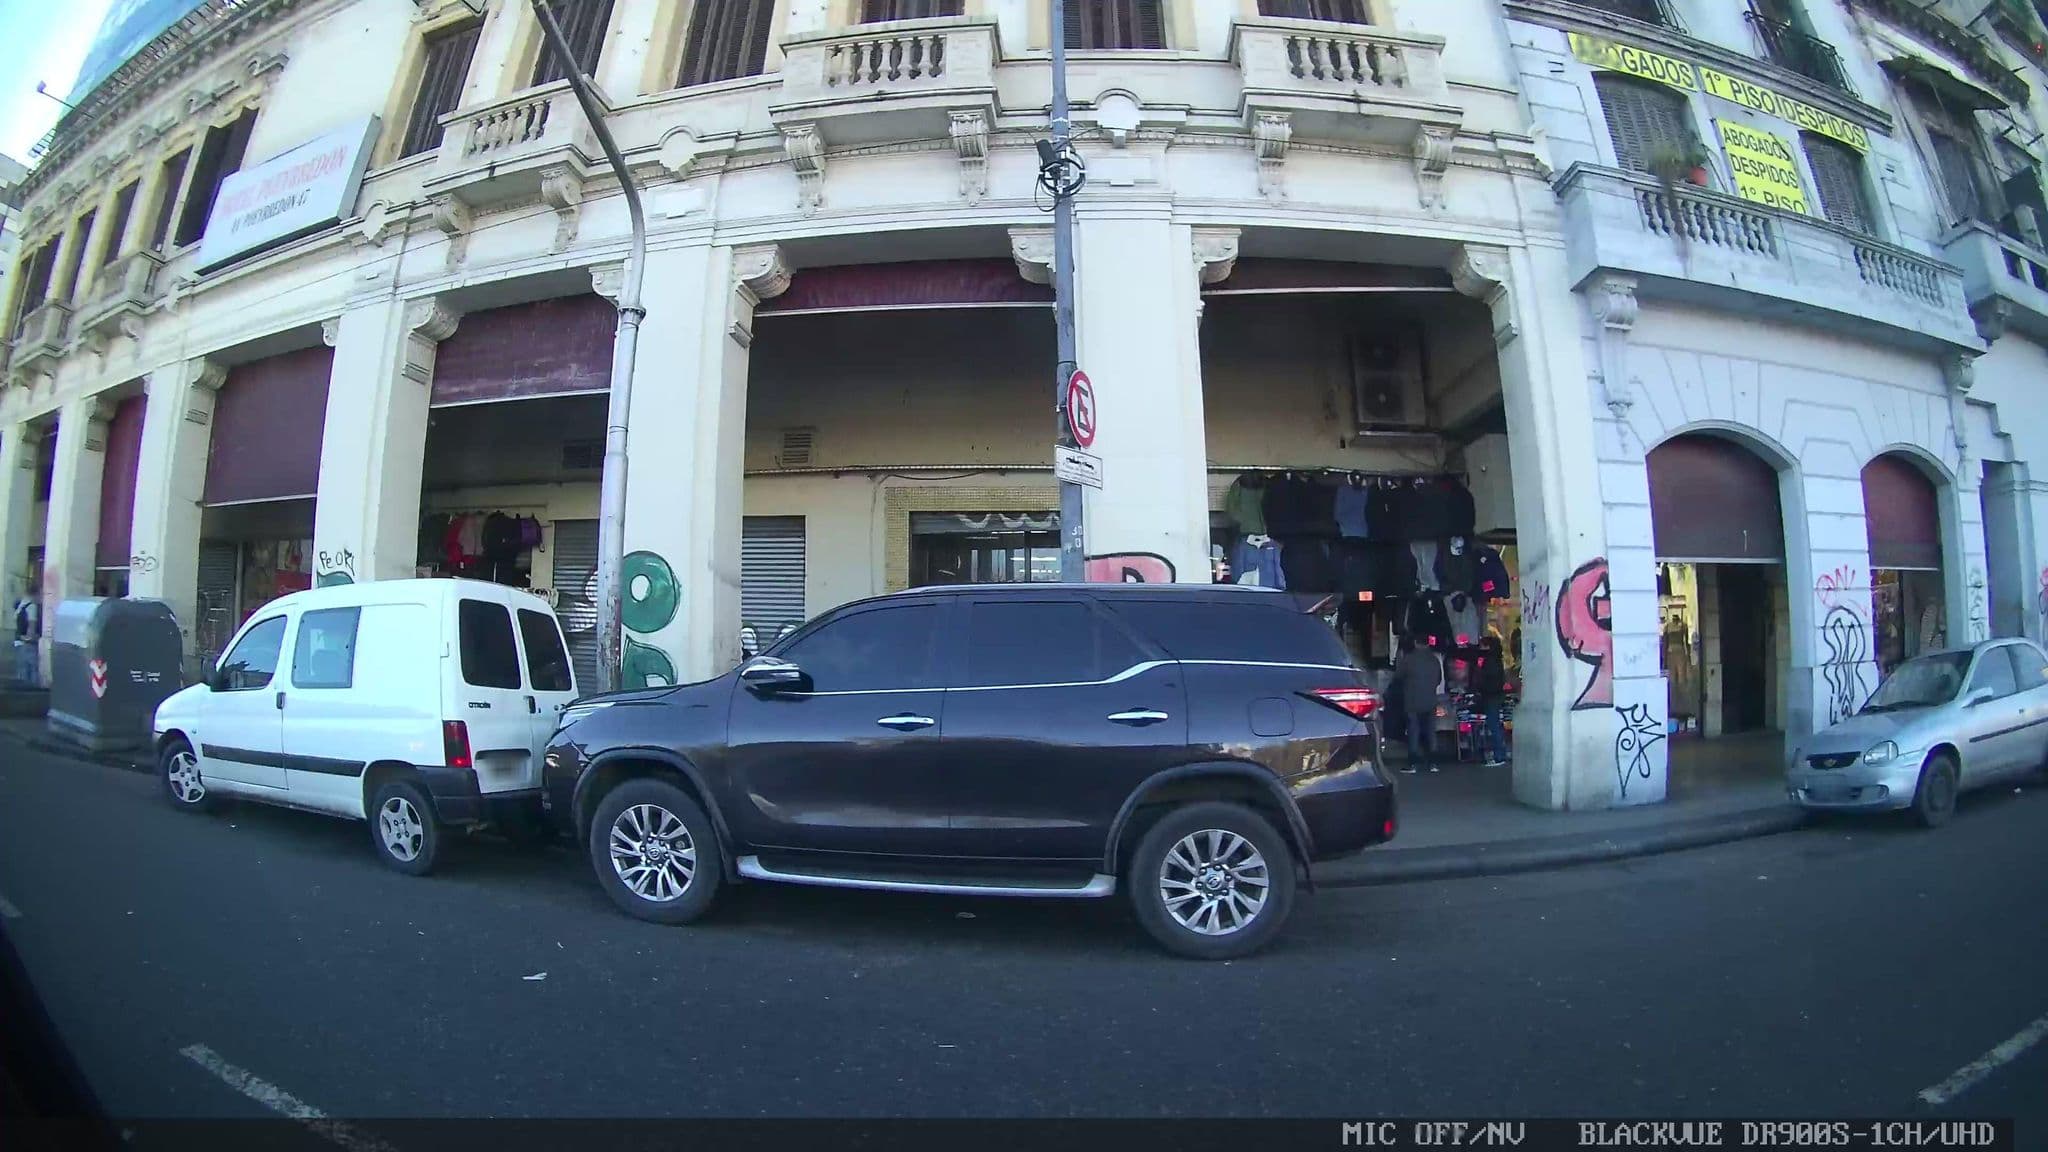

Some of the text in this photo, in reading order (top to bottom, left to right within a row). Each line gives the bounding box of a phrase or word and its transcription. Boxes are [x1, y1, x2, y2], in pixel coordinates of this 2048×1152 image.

[1728, 79, 1777, 114] PISO
[1780, 95, 1866, 148] DESPIDOS
[1723, 127, 1791, 161] ABOGADOS
[1729, 153, 1798, 189] DESPIDOS
[1762, 191, 1806, 214] PISO
